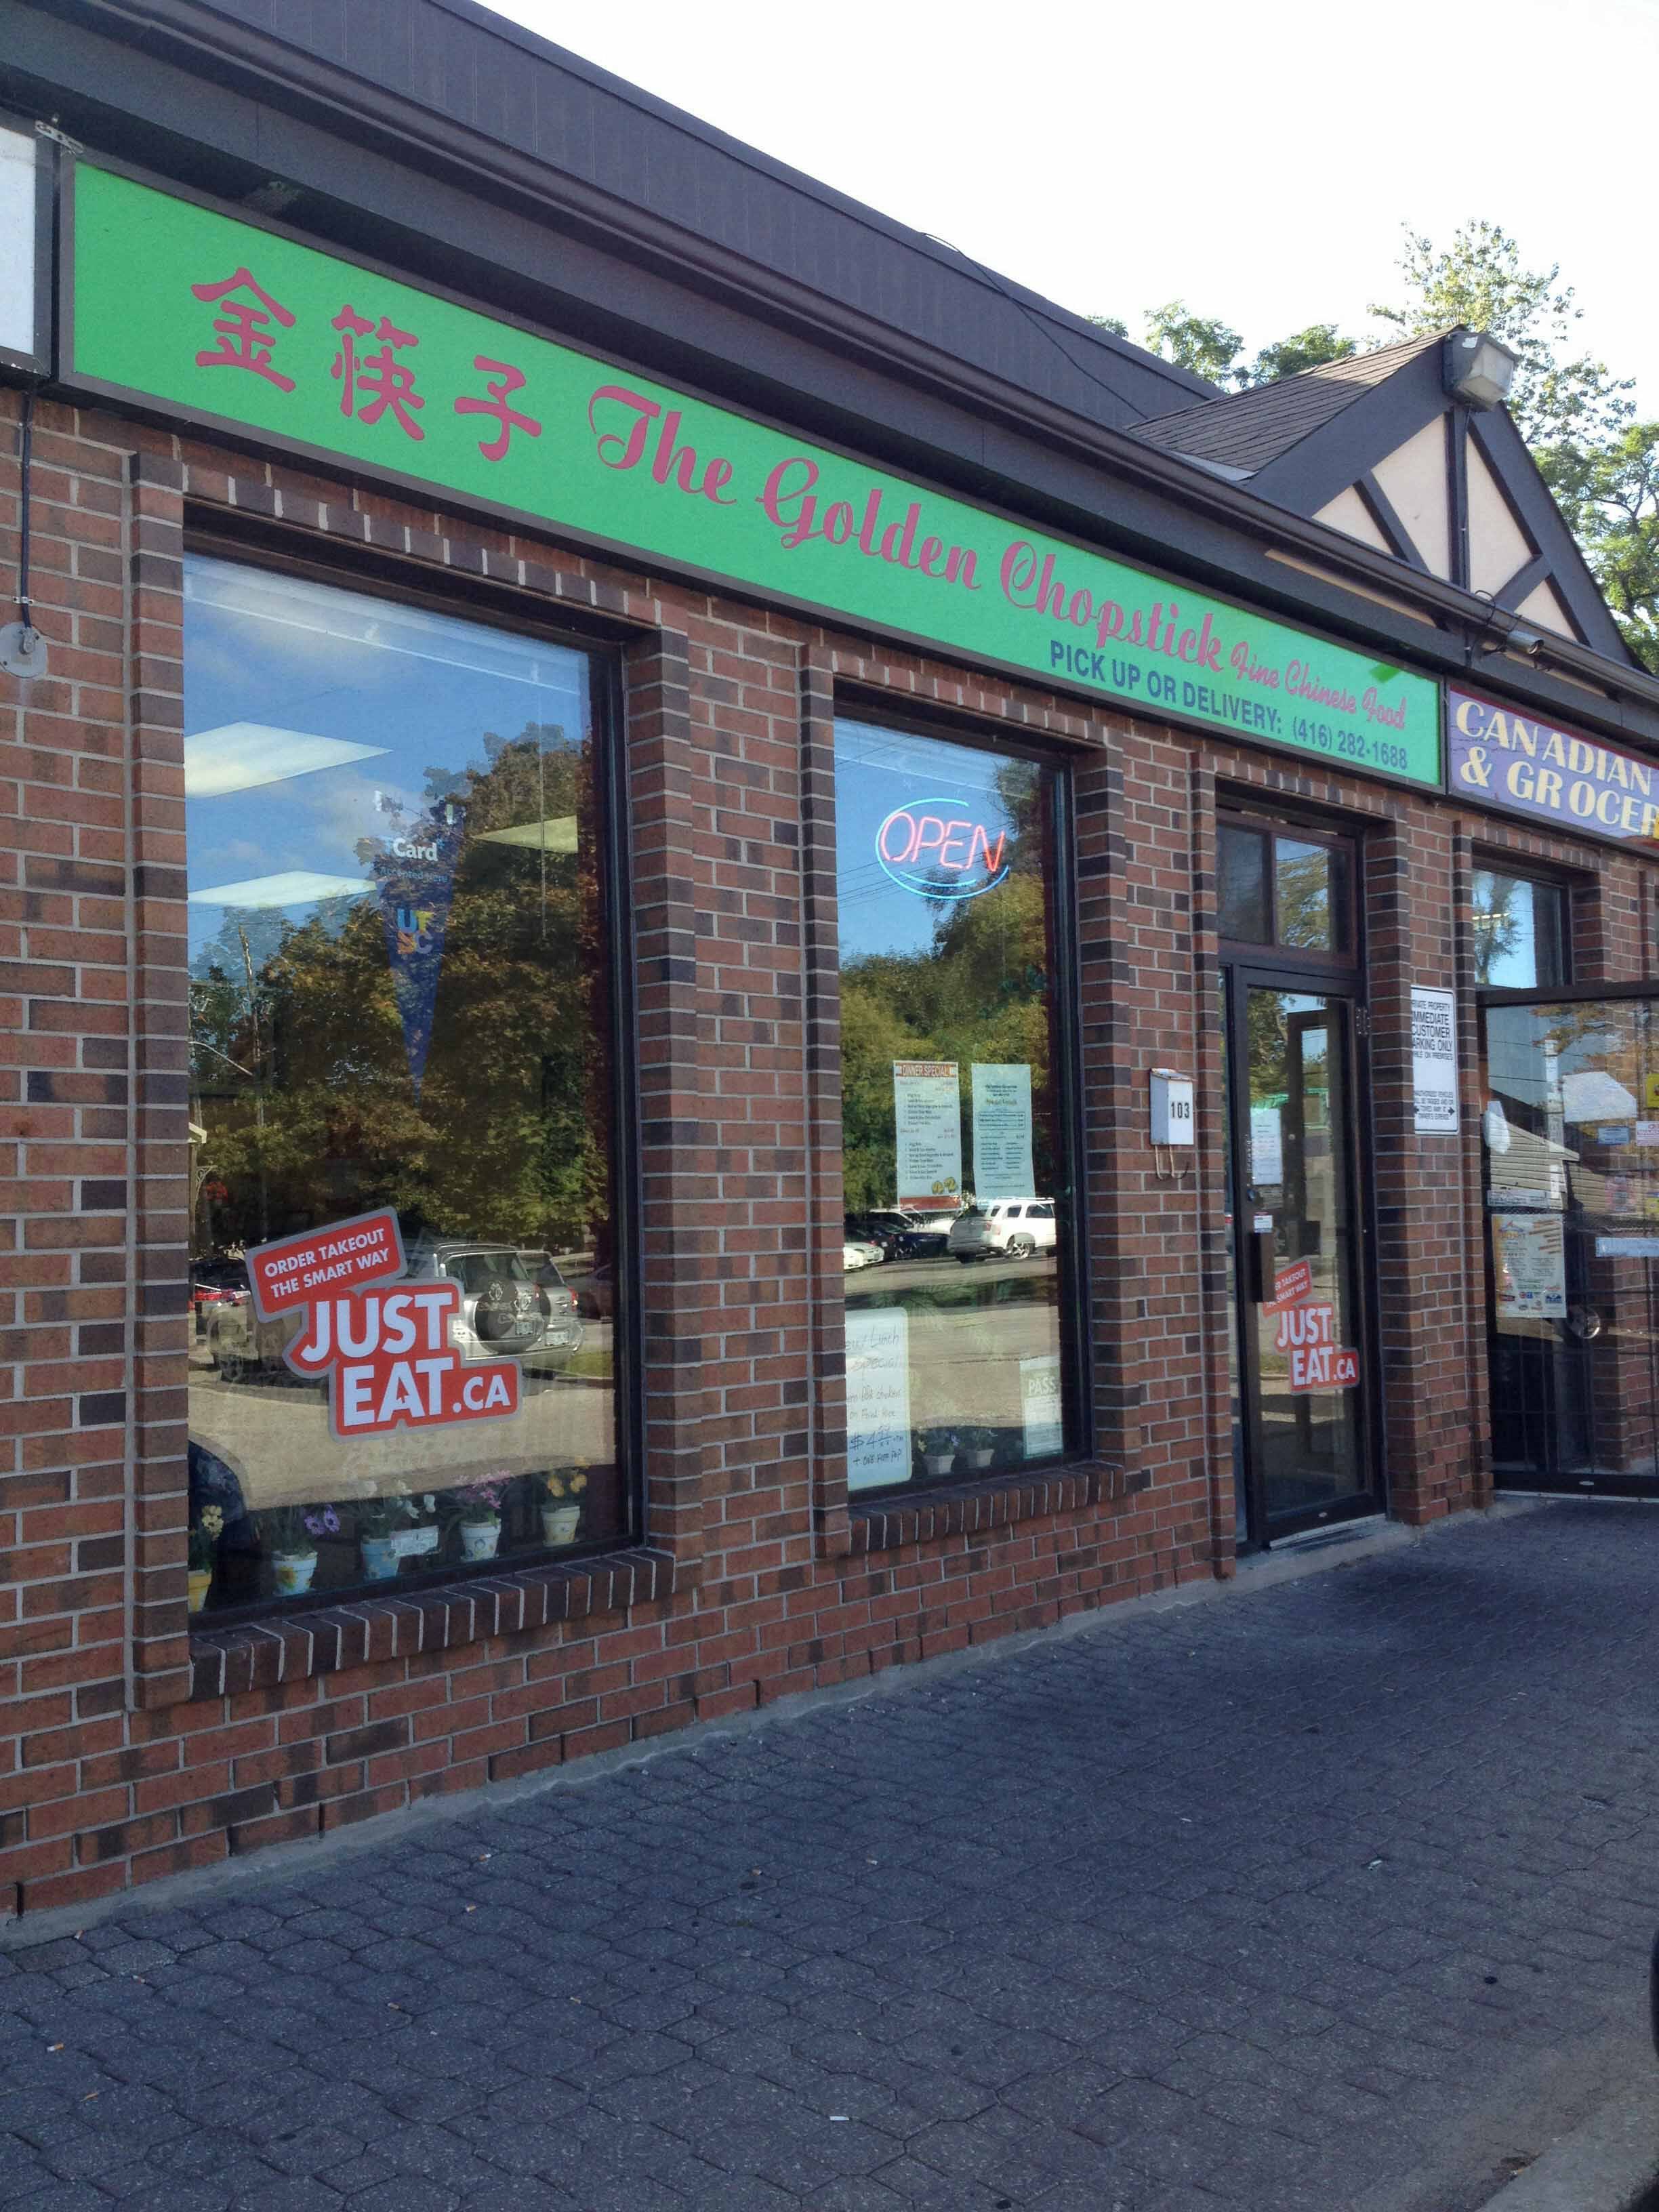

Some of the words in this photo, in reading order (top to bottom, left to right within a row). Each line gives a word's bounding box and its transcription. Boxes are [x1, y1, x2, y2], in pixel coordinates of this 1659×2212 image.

[190, 267, 541, 462] 金筷子
[588, 385, 737, 506] The
[754, 457, 982, 590] Golden
[1000, 540, 1225, 672] Chopstick
[1230, 641, 1280, 689] Fine
[1285, 659, 1357, 714] Chinese
[1362, 687, 1407, 730] Food
[1050, 639, 1106, 682] PICK
[1112, 659, 1141, 691] UP
[1147, 670, 1177, 703] OR
[1183, 680, 1282, 735] DELIVERY:
[1292, 716, 1333, 750] (416)
[1456, 701, 1652, 797] CANADIAN
[1460, 746, 1492, 788] &
[880, 812, 1006, 872] OPEN
[1412, 1012, 1450, 1026] MMEDIATE
[1412, 1024, 1451, 1038] CUSTOMER
[1412, 1038, 1436, 1052] ARKING
[902, 1065, 922, 1076] DINNER
[1170, 1102, 1190, 1120] 103
[264, 1250, 316, 1279] ORDER
[319, 1228, 386, 1261] TAKEOUT
[270, 1277, 300, 1298] THE
[304, 1260, 353, 1289] SMART
[358, 1247, 390, 1271] WAY
[300, 1292, 453, 1362] JUST
[1277, 1307, 1332, 1347] JUST
[1029, 1376, 1057, 1395] PASS
[1292, 1346, 1356, 1387] EAT.CA
[342, 1357, 510, 1427] EAT.CA
